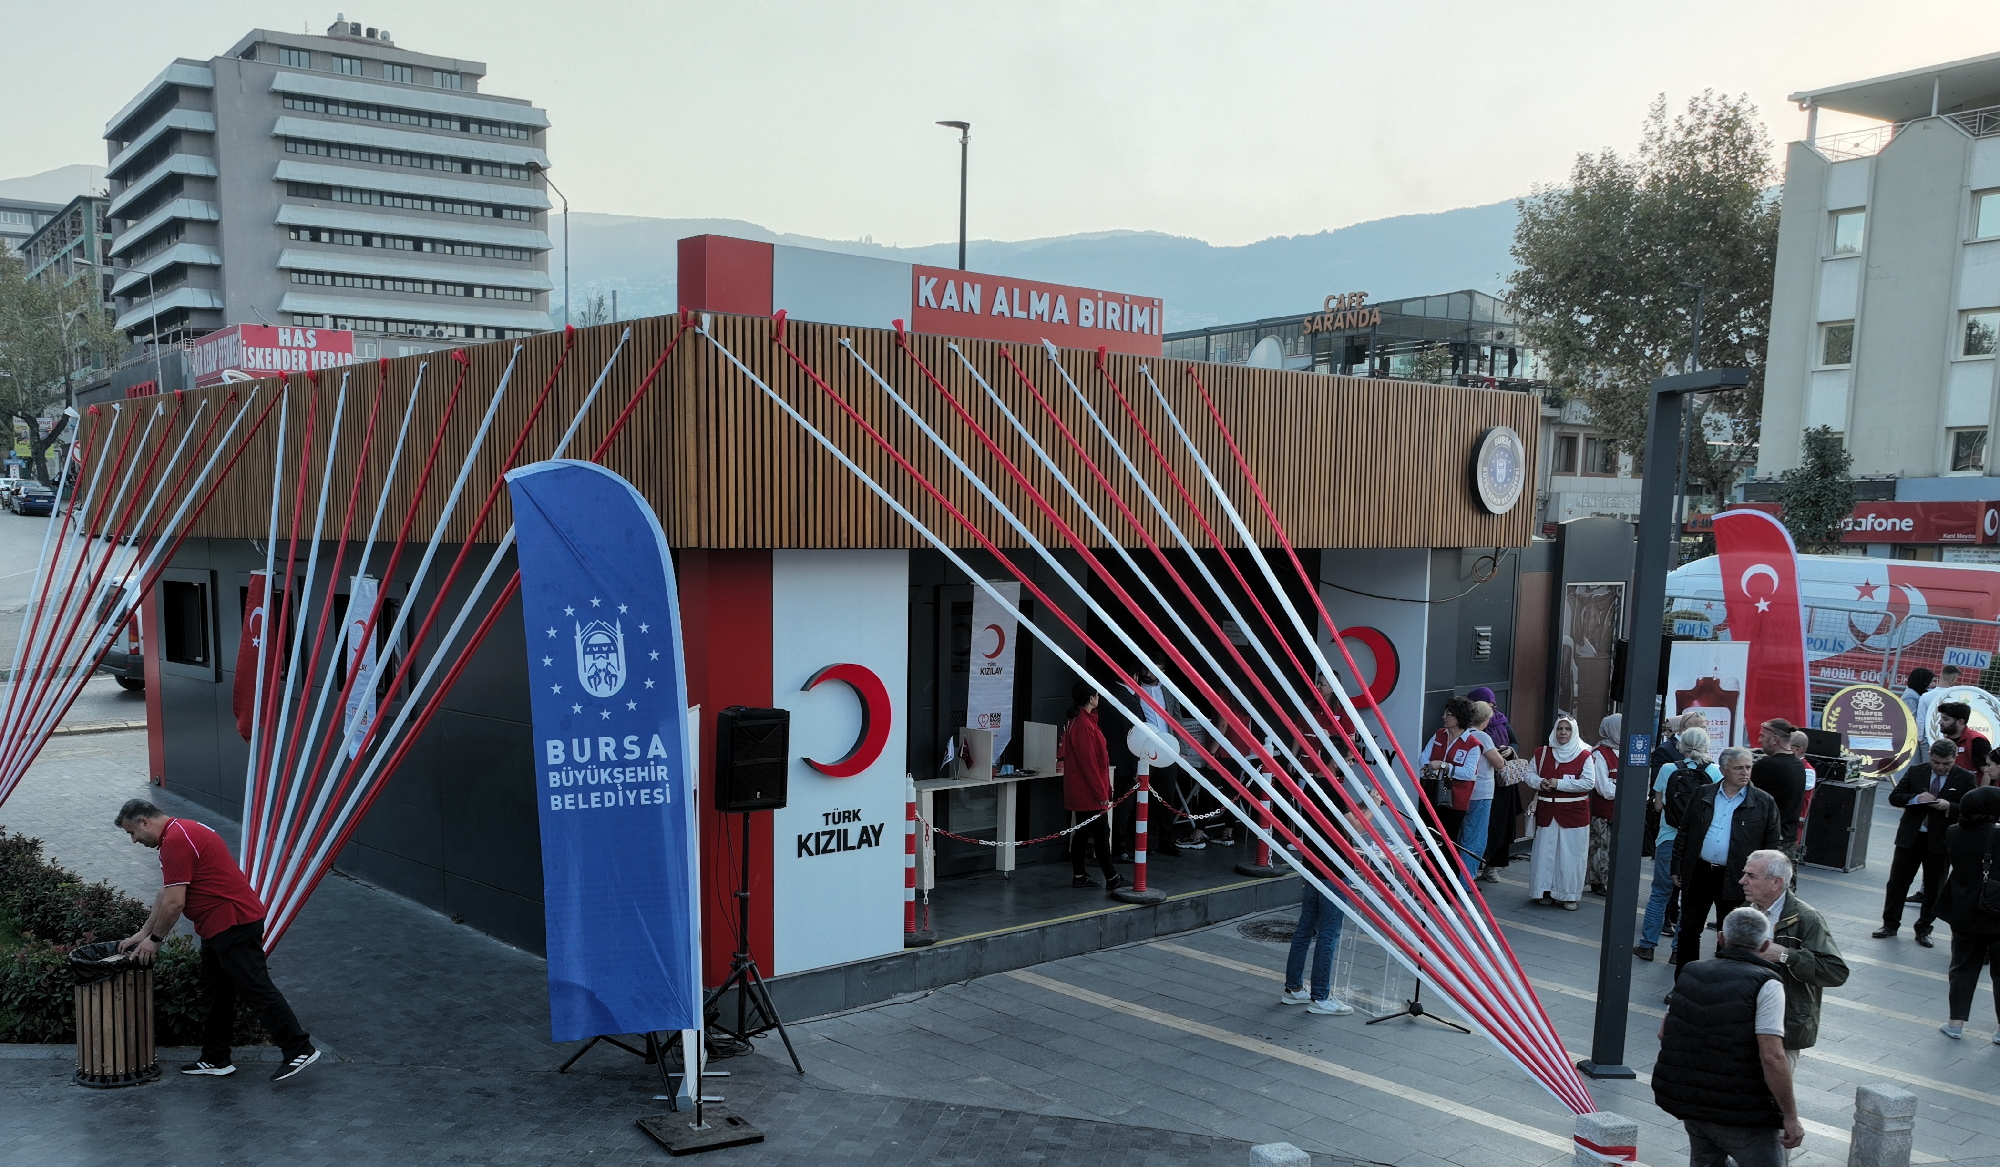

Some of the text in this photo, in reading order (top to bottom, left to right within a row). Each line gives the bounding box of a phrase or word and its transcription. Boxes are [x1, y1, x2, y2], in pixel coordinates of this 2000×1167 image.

[918, 276, 1159, 336] KAN ALMA BİRİMİ
[1323, 291, 1369, 313] CAFE
[1302, 306, 1382, 335] SARANDA
[277, 327, 317, 348] HAS
[242, 339, 307, 371] İSKENDER
[1494, 435, 1512, 449] BURSA
[1828, 513, 1914, 532] dafone
[1676, 622, 1709, 637] POLİS
[1806, 637, 1845, 653] POLİS
[1947, 651, 1987, 668] POLİS
[980, 666, 1003, 676] KIZILAY
[1820, 667, 1857, 680] MOBİL
[546, 734, 668, 765] BURSA
[548, 760, 669, 788] BÜYÜKŞEHİR
[550, 783, 671, 811] BELEDİYESİ
[822, 807, 862, 826] TÜRK
[797, 822, 885, 859] KIZILAY
